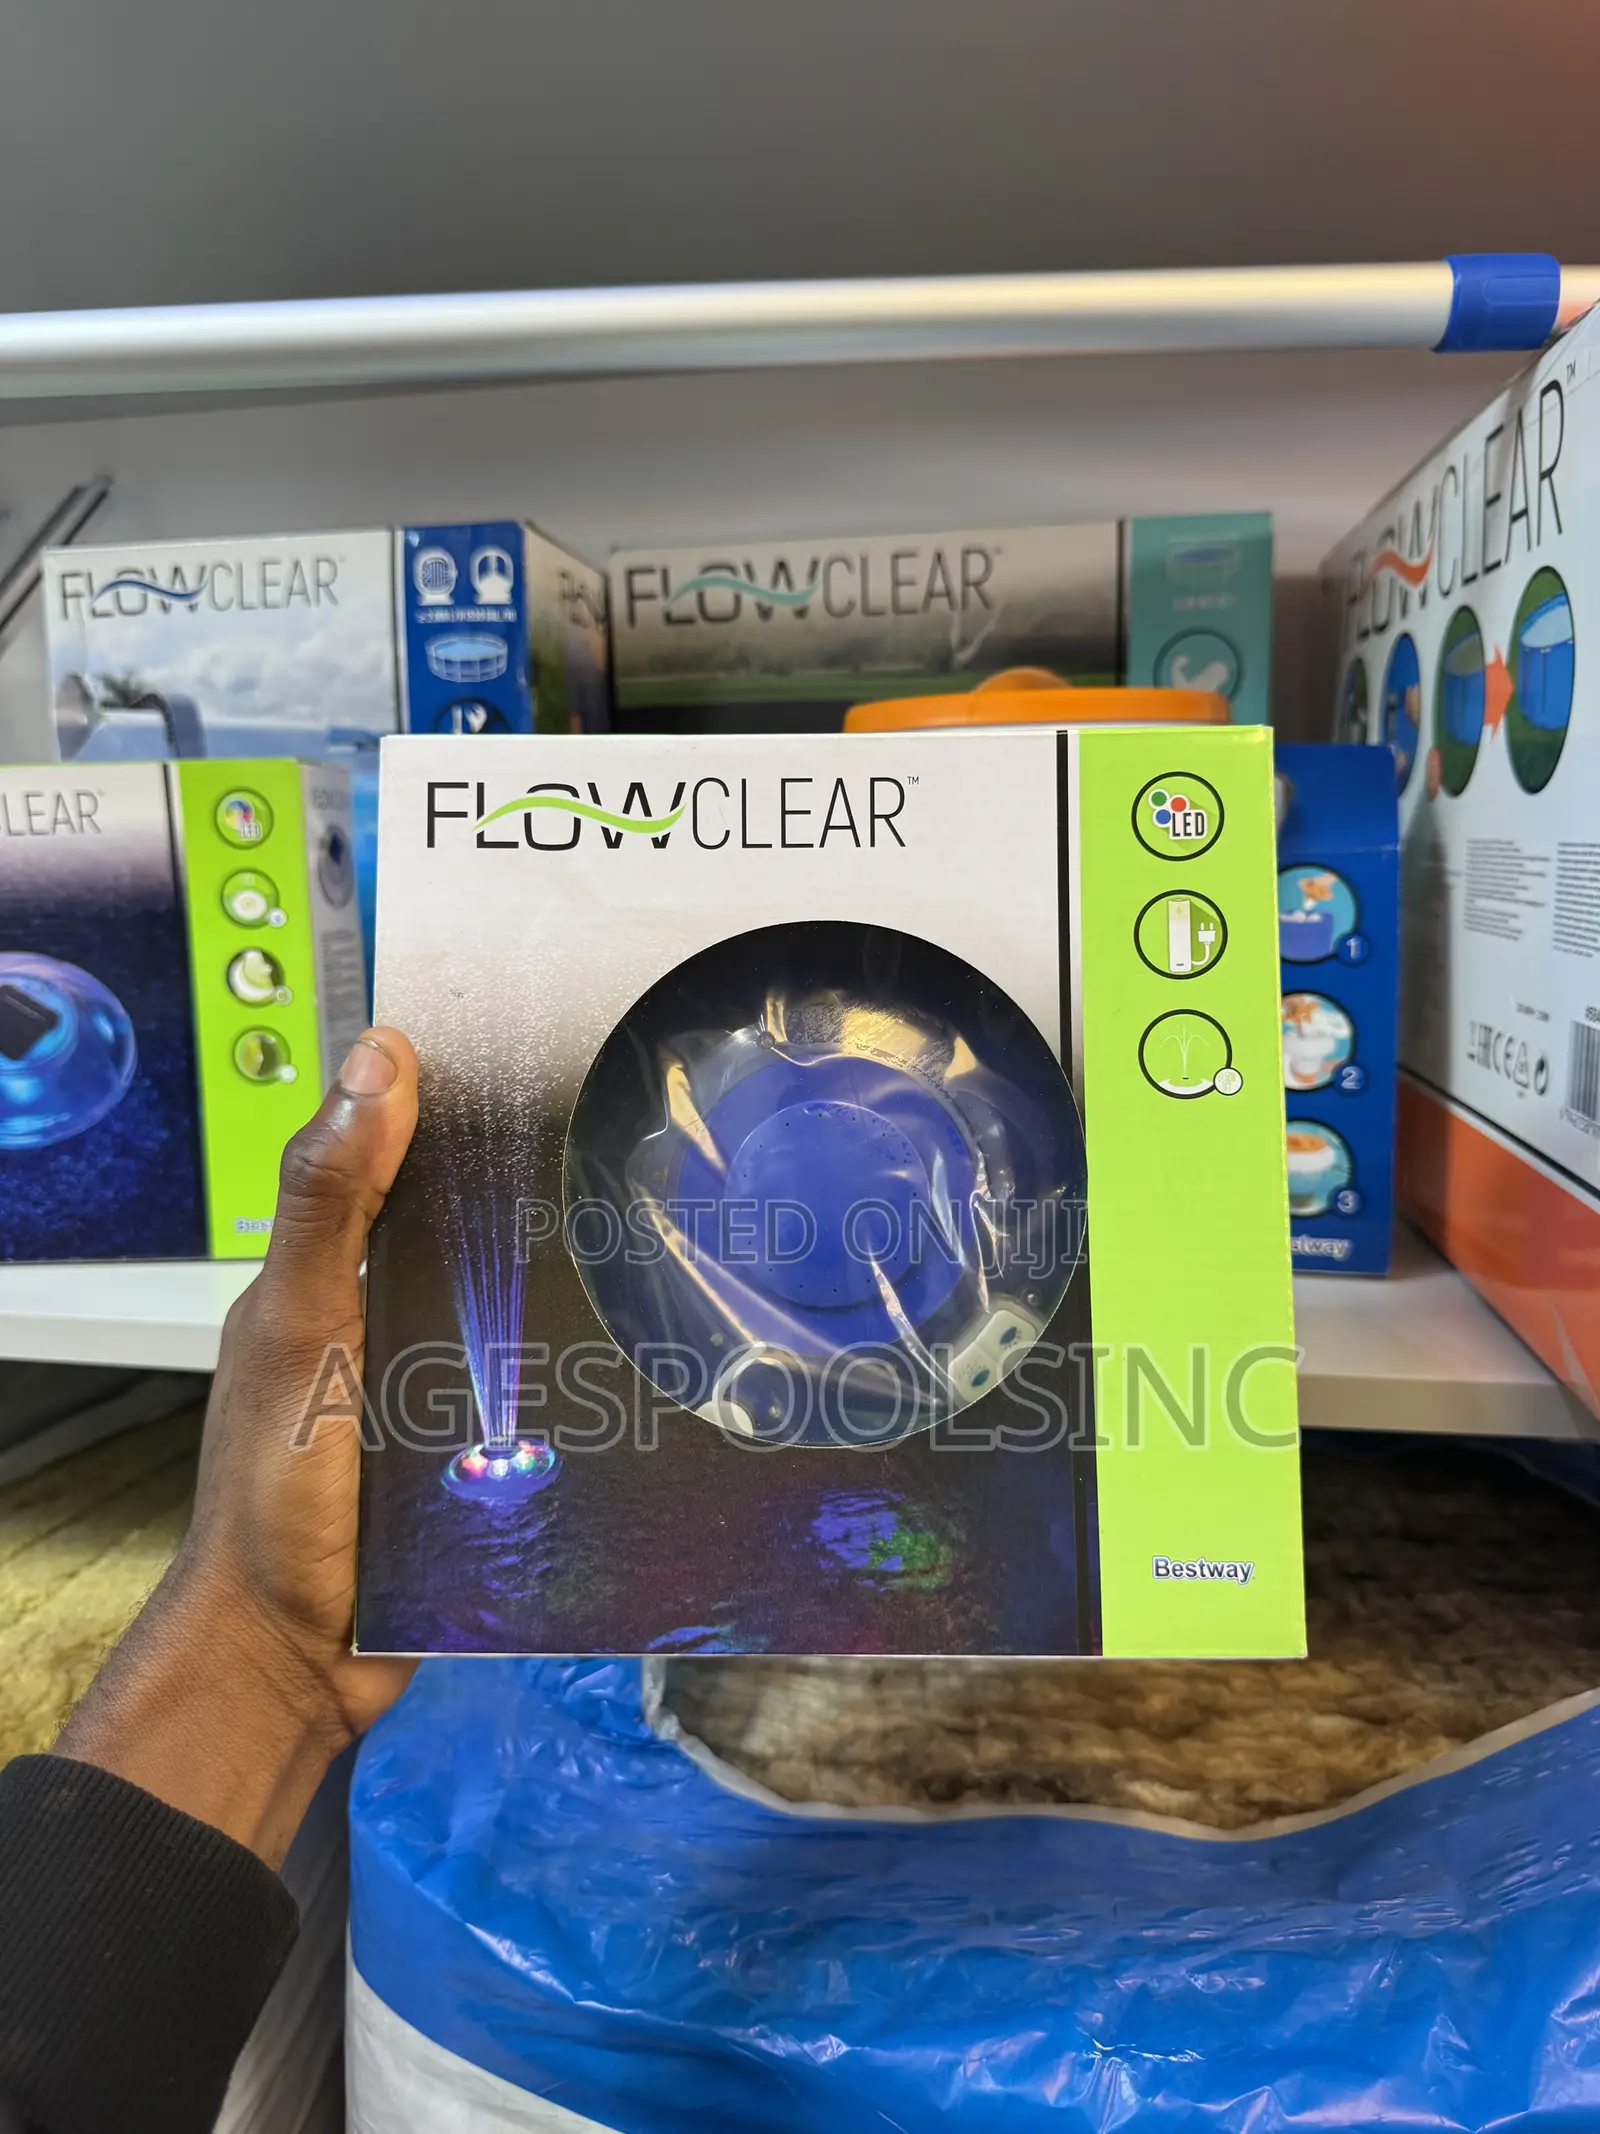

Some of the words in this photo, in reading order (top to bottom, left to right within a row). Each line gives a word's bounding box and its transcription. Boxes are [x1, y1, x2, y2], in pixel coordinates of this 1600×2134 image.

[60, 557, 340, 620] FLOWCLEAR
[624, 546, 996, 628] FLOWCLEAR
[0, 789, 102, 836] LEAR
[426, 777, 906, 851] FLOWCLEAR
[1171, 812, 1205, 837] LED
[1346, 937, 1361, 959] 1
[1341, 1066, 1361, 1089] 2
[1337, 1190, 1360, 1214] 3
[1152, 1556, 1254, 1584] Bestway
